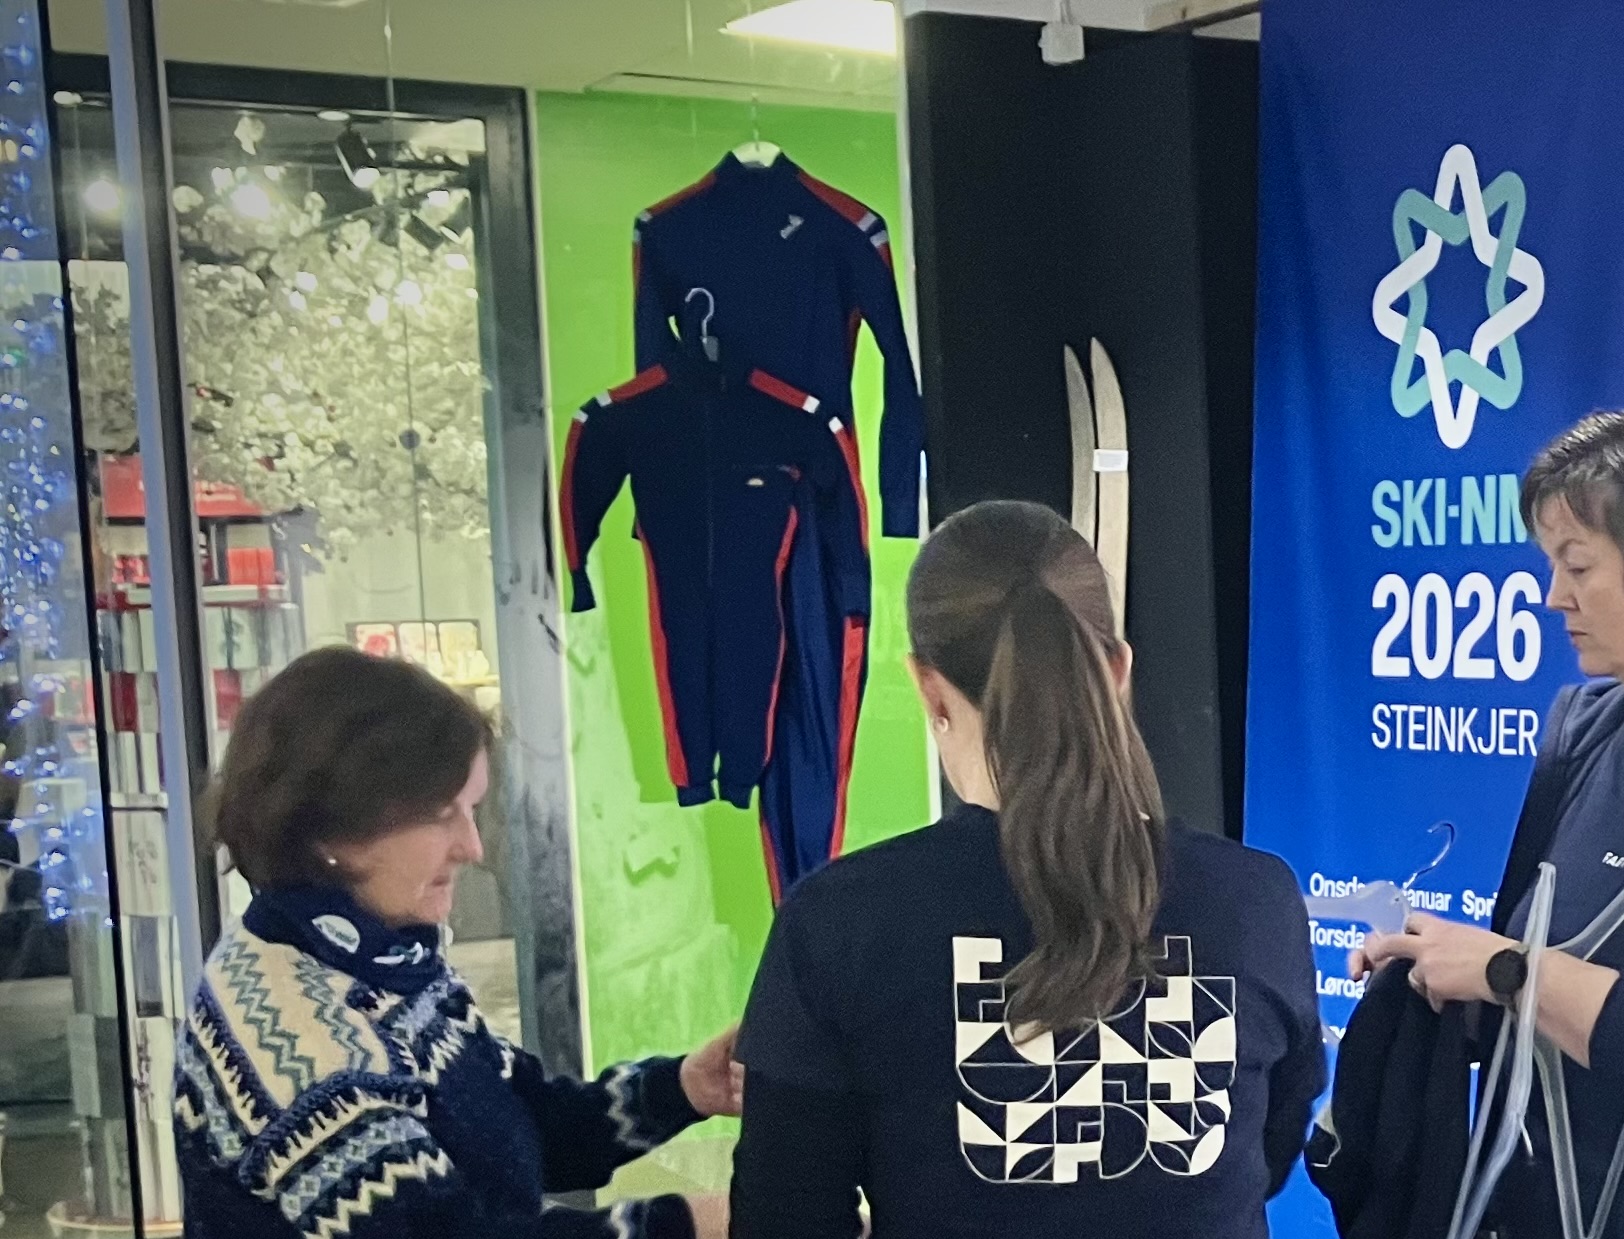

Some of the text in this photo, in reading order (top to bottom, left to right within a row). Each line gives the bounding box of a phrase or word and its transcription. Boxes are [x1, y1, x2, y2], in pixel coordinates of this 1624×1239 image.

[1371, 571, 1543, 682] 2026
[1371, 703, 1539, 757] STEINKJER
[1402, 889, 1452, 911] anuar
[1462, 889, 1499, 921] Spr
